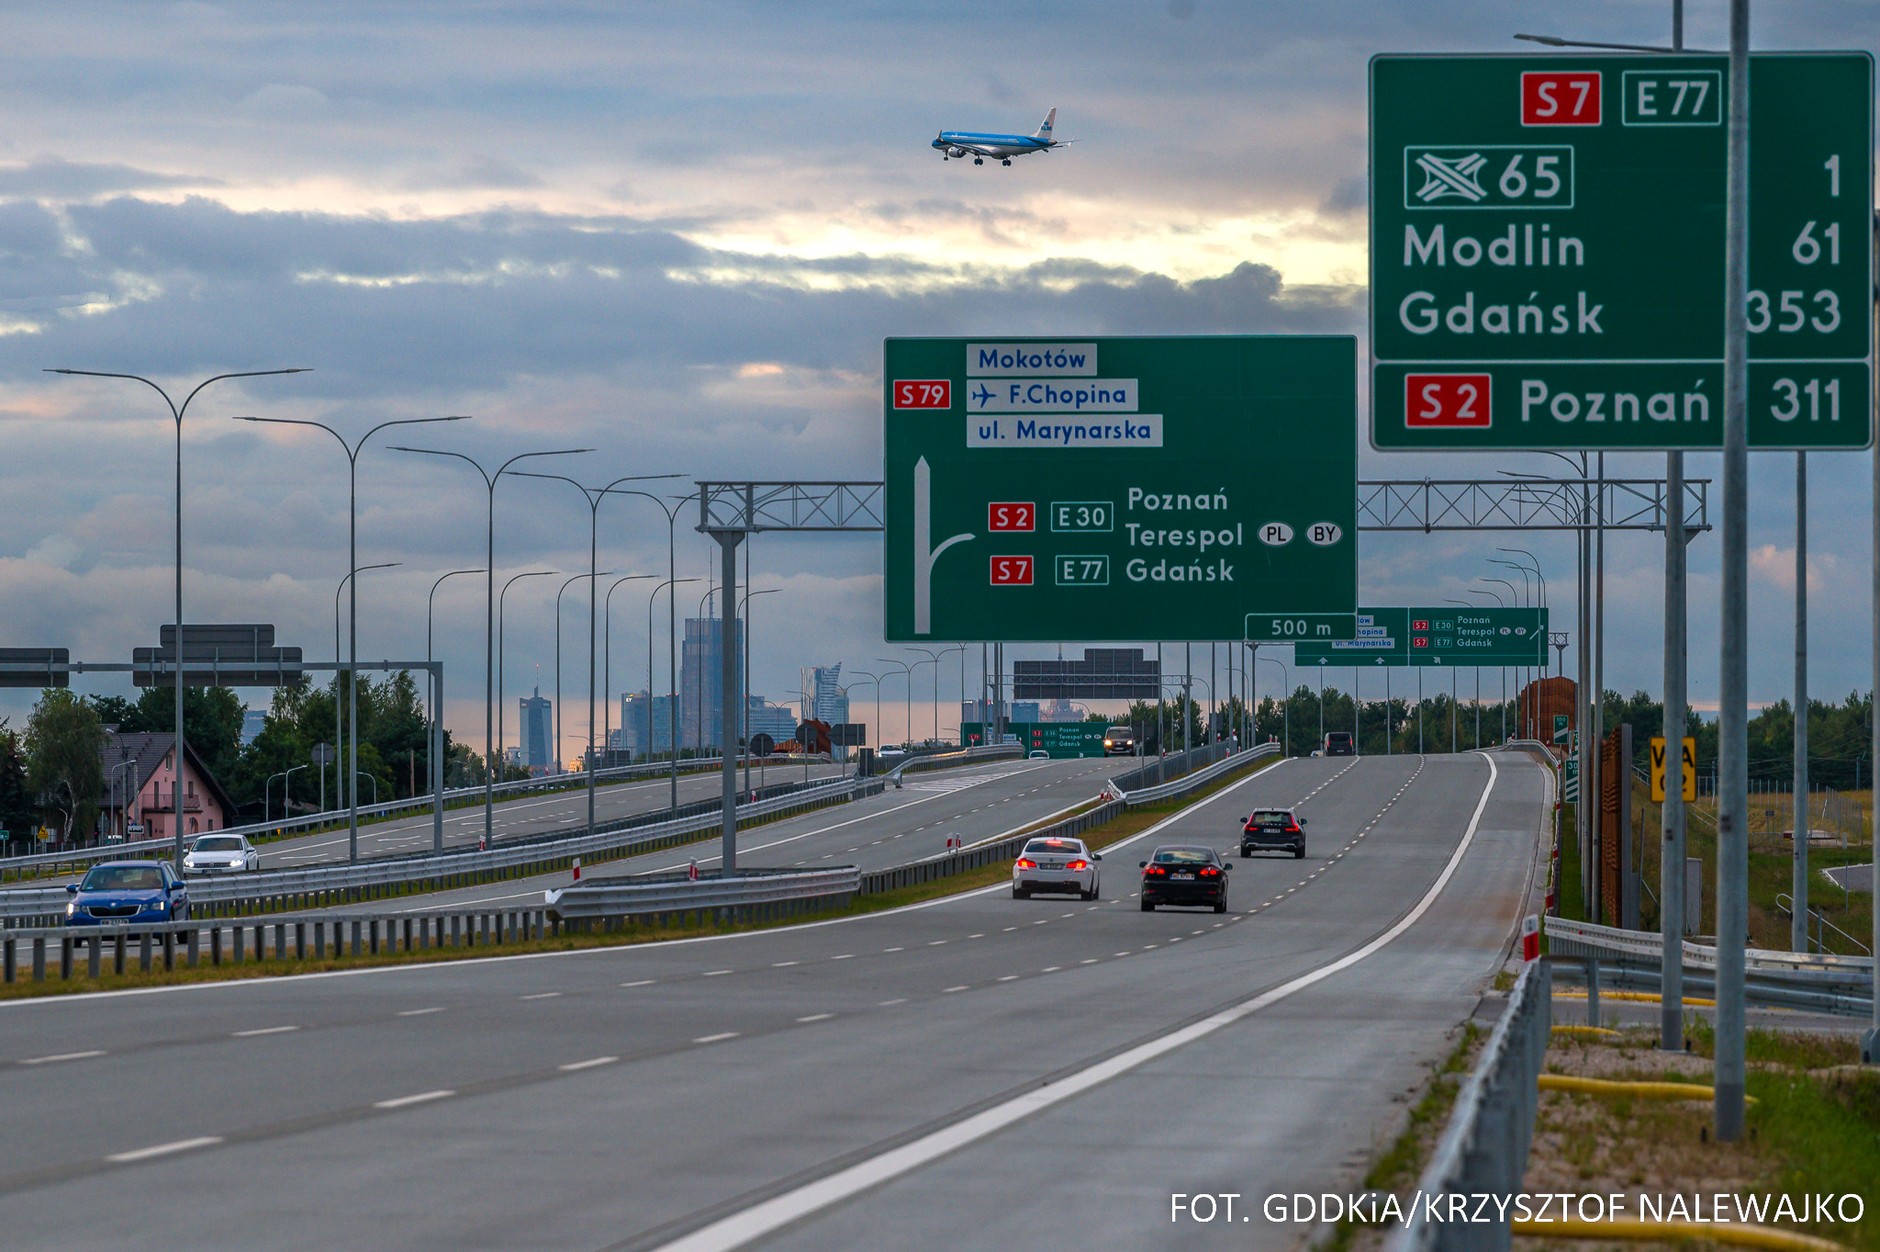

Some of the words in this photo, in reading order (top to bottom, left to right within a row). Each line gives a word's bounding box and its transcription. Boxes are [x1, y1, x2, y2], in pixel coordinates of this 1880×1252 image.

[1499, 155, 1560, 198] 65
[1824, 154, 1840, 197] 1
[1403, 224, 1584, 267] Modlin
[1792, 221, 1840, 265] 61
[1399, 290, 1604, 335] Gdańsk
[1746, 289, 1841, 333] 353
[979, 348, 1086, 369] Mokotów
[1009, 384, 1126, 409] F.Chopina
[1521, 379, 1709, 422] Poznań
[1770, 378, 1839, 422] 311
[979, 420, 1005, 440] ul.
[1016, 420, 1151, 445] Marynarska
[1129, 487, 1228, 510] Poznań
[1125, 523, 1242, 553] Terespol
[1267, 526, 1286, 542] PL
[1314, 526, 1336, 541] BY
[1125, 559, 1234, 582] Gdańsk
[1271, 619, 1307, 636] 500
[1316, 624, 1331, 636] m
[1457, 615, 1491, 624] Poznań
[1347, 640, 1392, 648] Marynarska
[1456, 627, 1495, 638] Terespol
[1456, 638, 1492, 647] Gdańsk
